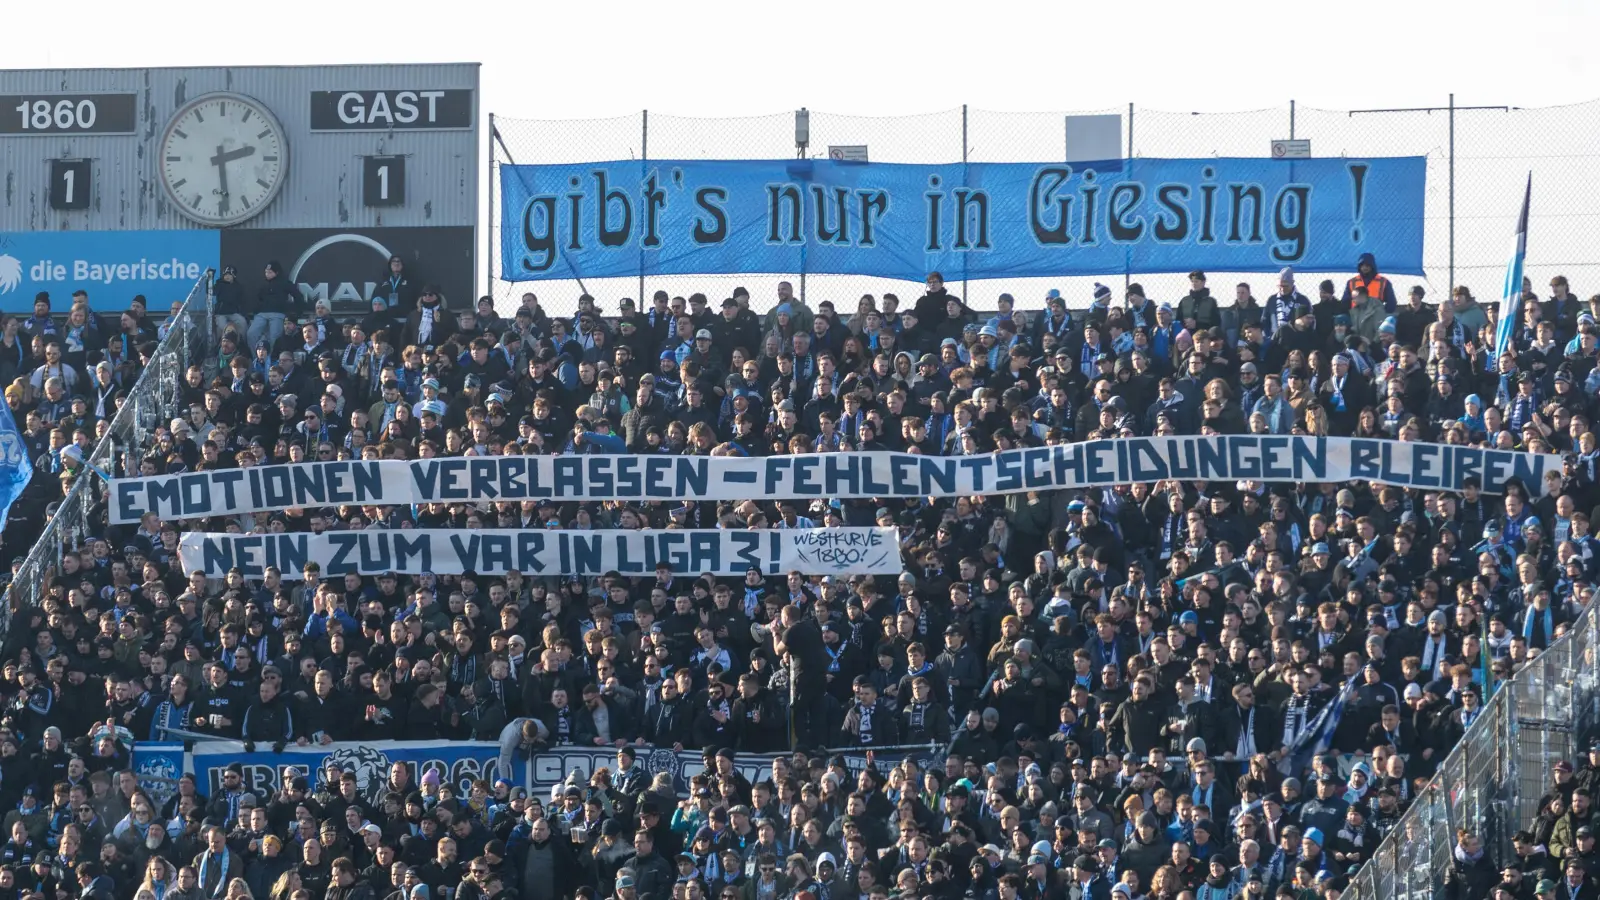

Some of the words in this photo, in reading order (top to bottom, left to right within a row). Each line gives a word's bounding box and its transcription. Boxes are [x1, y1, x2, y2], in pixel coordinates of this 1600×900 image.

[15, 100, 97, 129] 1860
[337, 90, 445, 124] GAST
[63, 169, 75, 203] 1
[377, 166, 389, 200] 1
[521, 167, 729, 273] gibt's
[764, 180, 890, 249] nur
[924, 174, 992, 251] in
[1027, 163, 1312, 264] Giesing
[30, 259, 67, 282] die
[73, 257, 200, 285] Bayerische
[117, 460, 383, 521] EMOTIONEN
[410, 456, 709, 499] VERBLASSEN
[764, 435, 1327, 496] FEHLENTSCHEIDUNGEN
[1350, 437, 1546, 498] BLEIBEN
[202, 533, 308, 575] NEIN
[327, 533, 432, 575] ZUM
[450, 532, 547, 573] VAR
[558, 532, 600, 573] IN
[615, 532, 722, 573] LIGA
[793, 528, 883, 548] WESTKURVE
